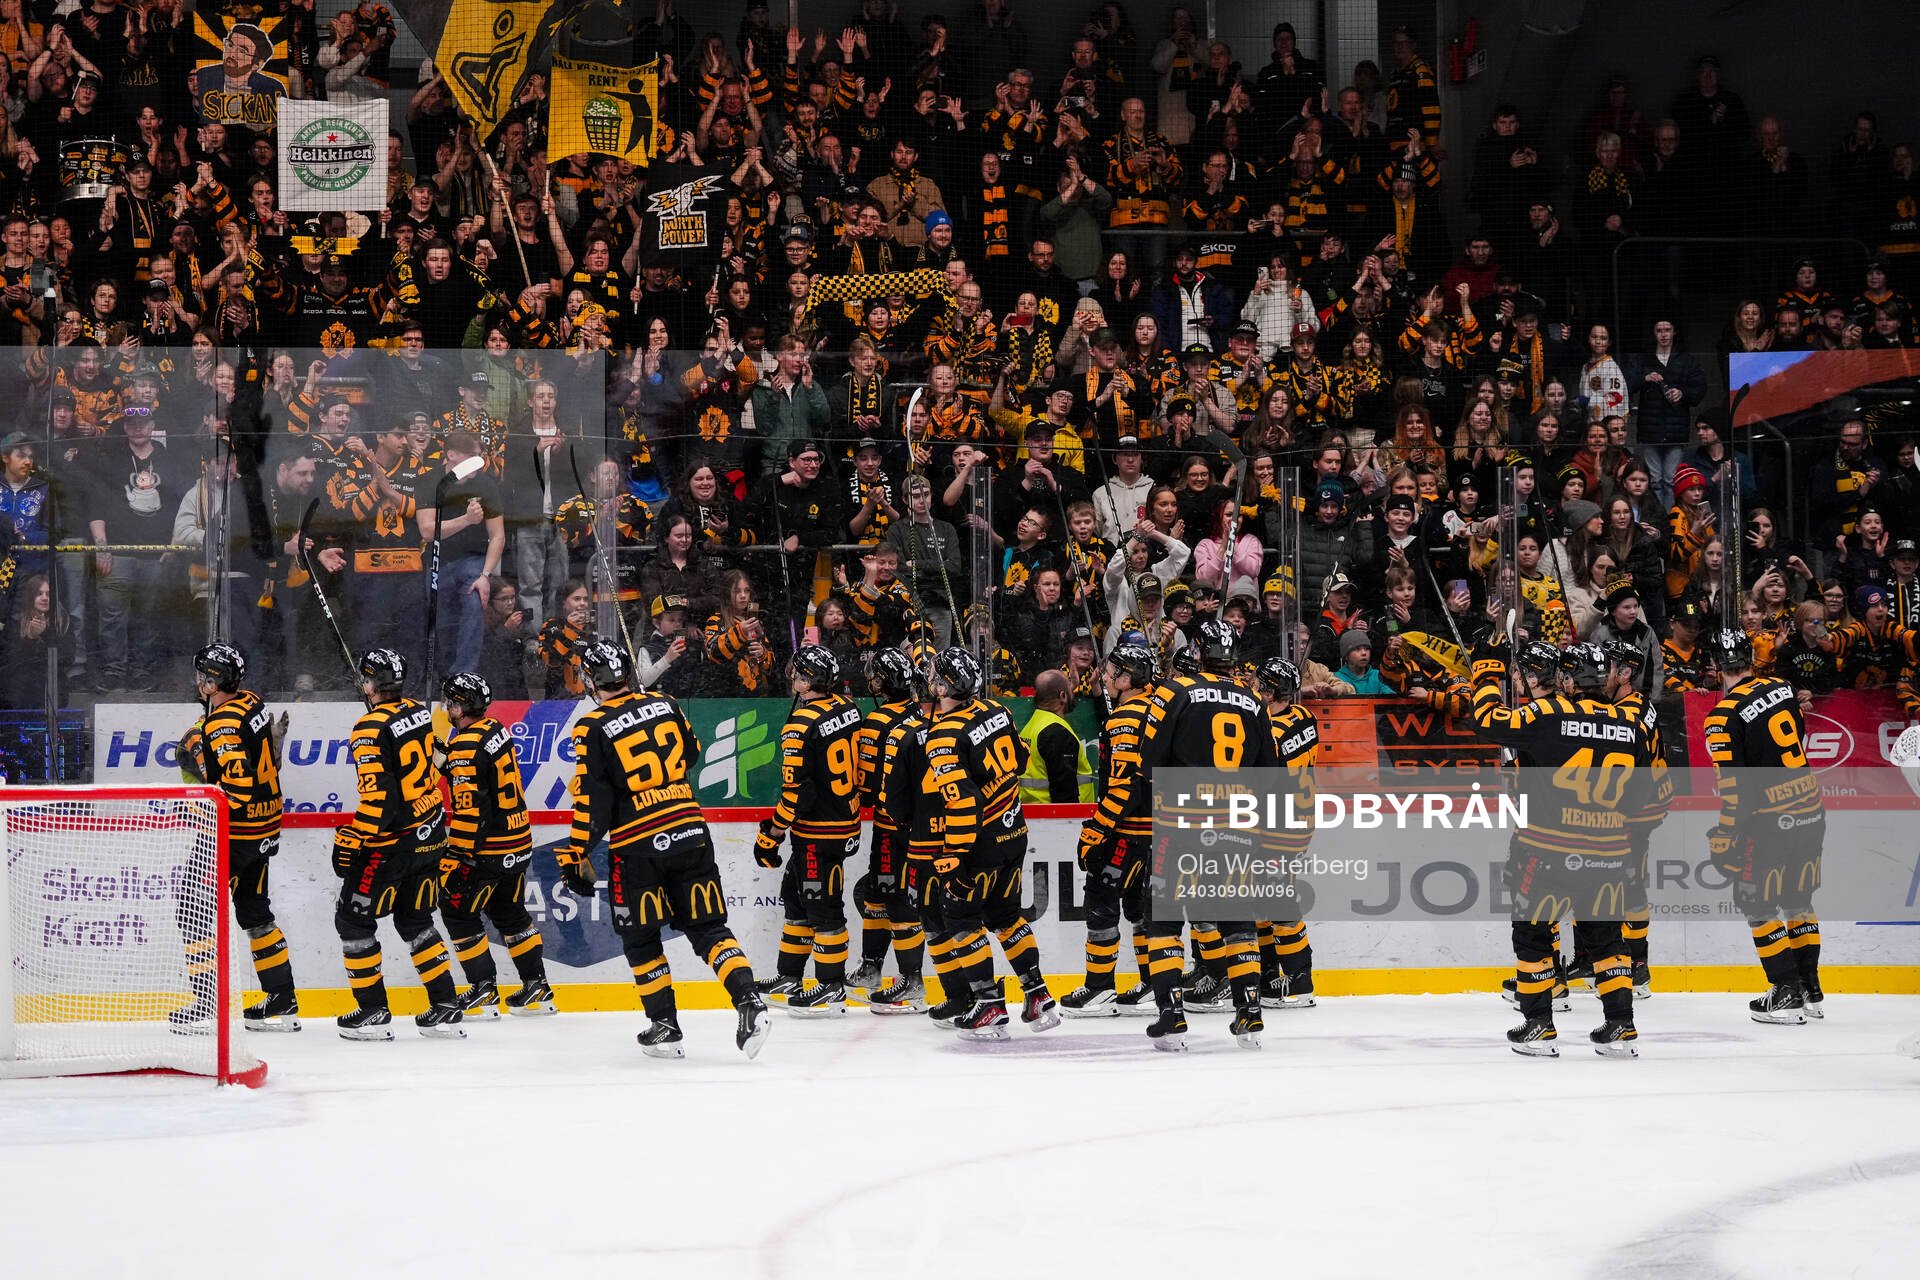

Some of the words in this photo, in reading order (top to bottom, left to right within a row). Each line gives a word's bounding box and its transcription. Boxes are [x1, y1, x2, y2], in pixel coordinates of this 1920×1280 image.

[588, 75, 617, 86] RENT
[203, 89, 278, 125] SICKAN
[291, 147, 374, 161] Heikkinen
[663, 216, 703, 231] NORTH
[662, 229, 704, 245] POWER
[1610, 378, 1620, 389] 16
[431, 540, 441, 591] CCM
[314, 583, 333, 619] CCM
[1193, 688, 1261, 717] BOLIDEN
[1743, 685, 1794, 723] BOLIDEN
[1109, 726, 1135, 736] HOLMEN
[1211, 712, 1246, 773] 8
[1567, 720, 1636, 743] BOLIDEN
[1767, 709, 1807, 769] 9
[613, 720, 687, 793] 52
[1552, 747, 1636, 809] 40
[454, 791, 473, 809] 58
[631, 783, 693, 812] LUNDBERG
[940, 782, 961, 802] 19
[1647, 902, 1710, 914] Process
